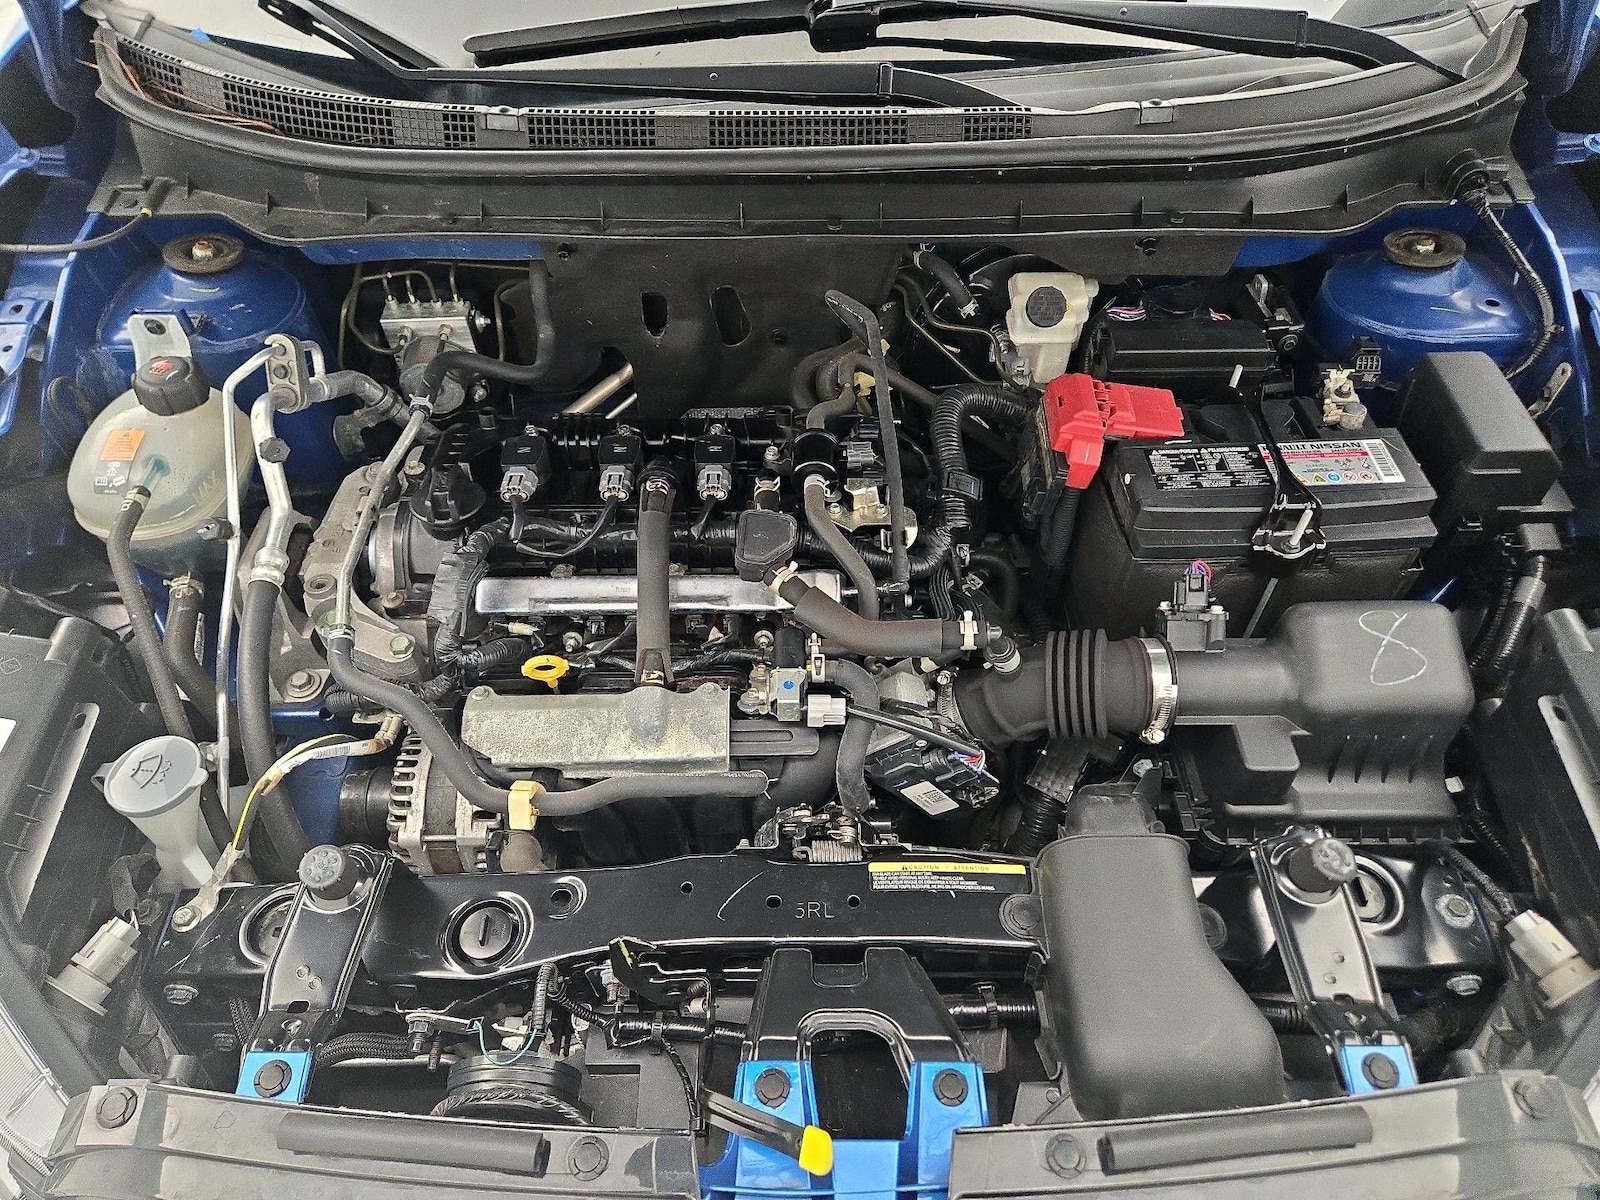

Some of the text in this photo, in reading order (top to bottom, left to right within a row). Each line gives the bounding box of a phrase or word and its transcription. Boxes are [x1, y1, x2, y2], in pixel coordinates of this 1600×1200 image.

[1310, 441, 1361, 449] NISSAN
[1358, 609, 1428, 686] 8
[795, 901, 835, 919] 5RL
